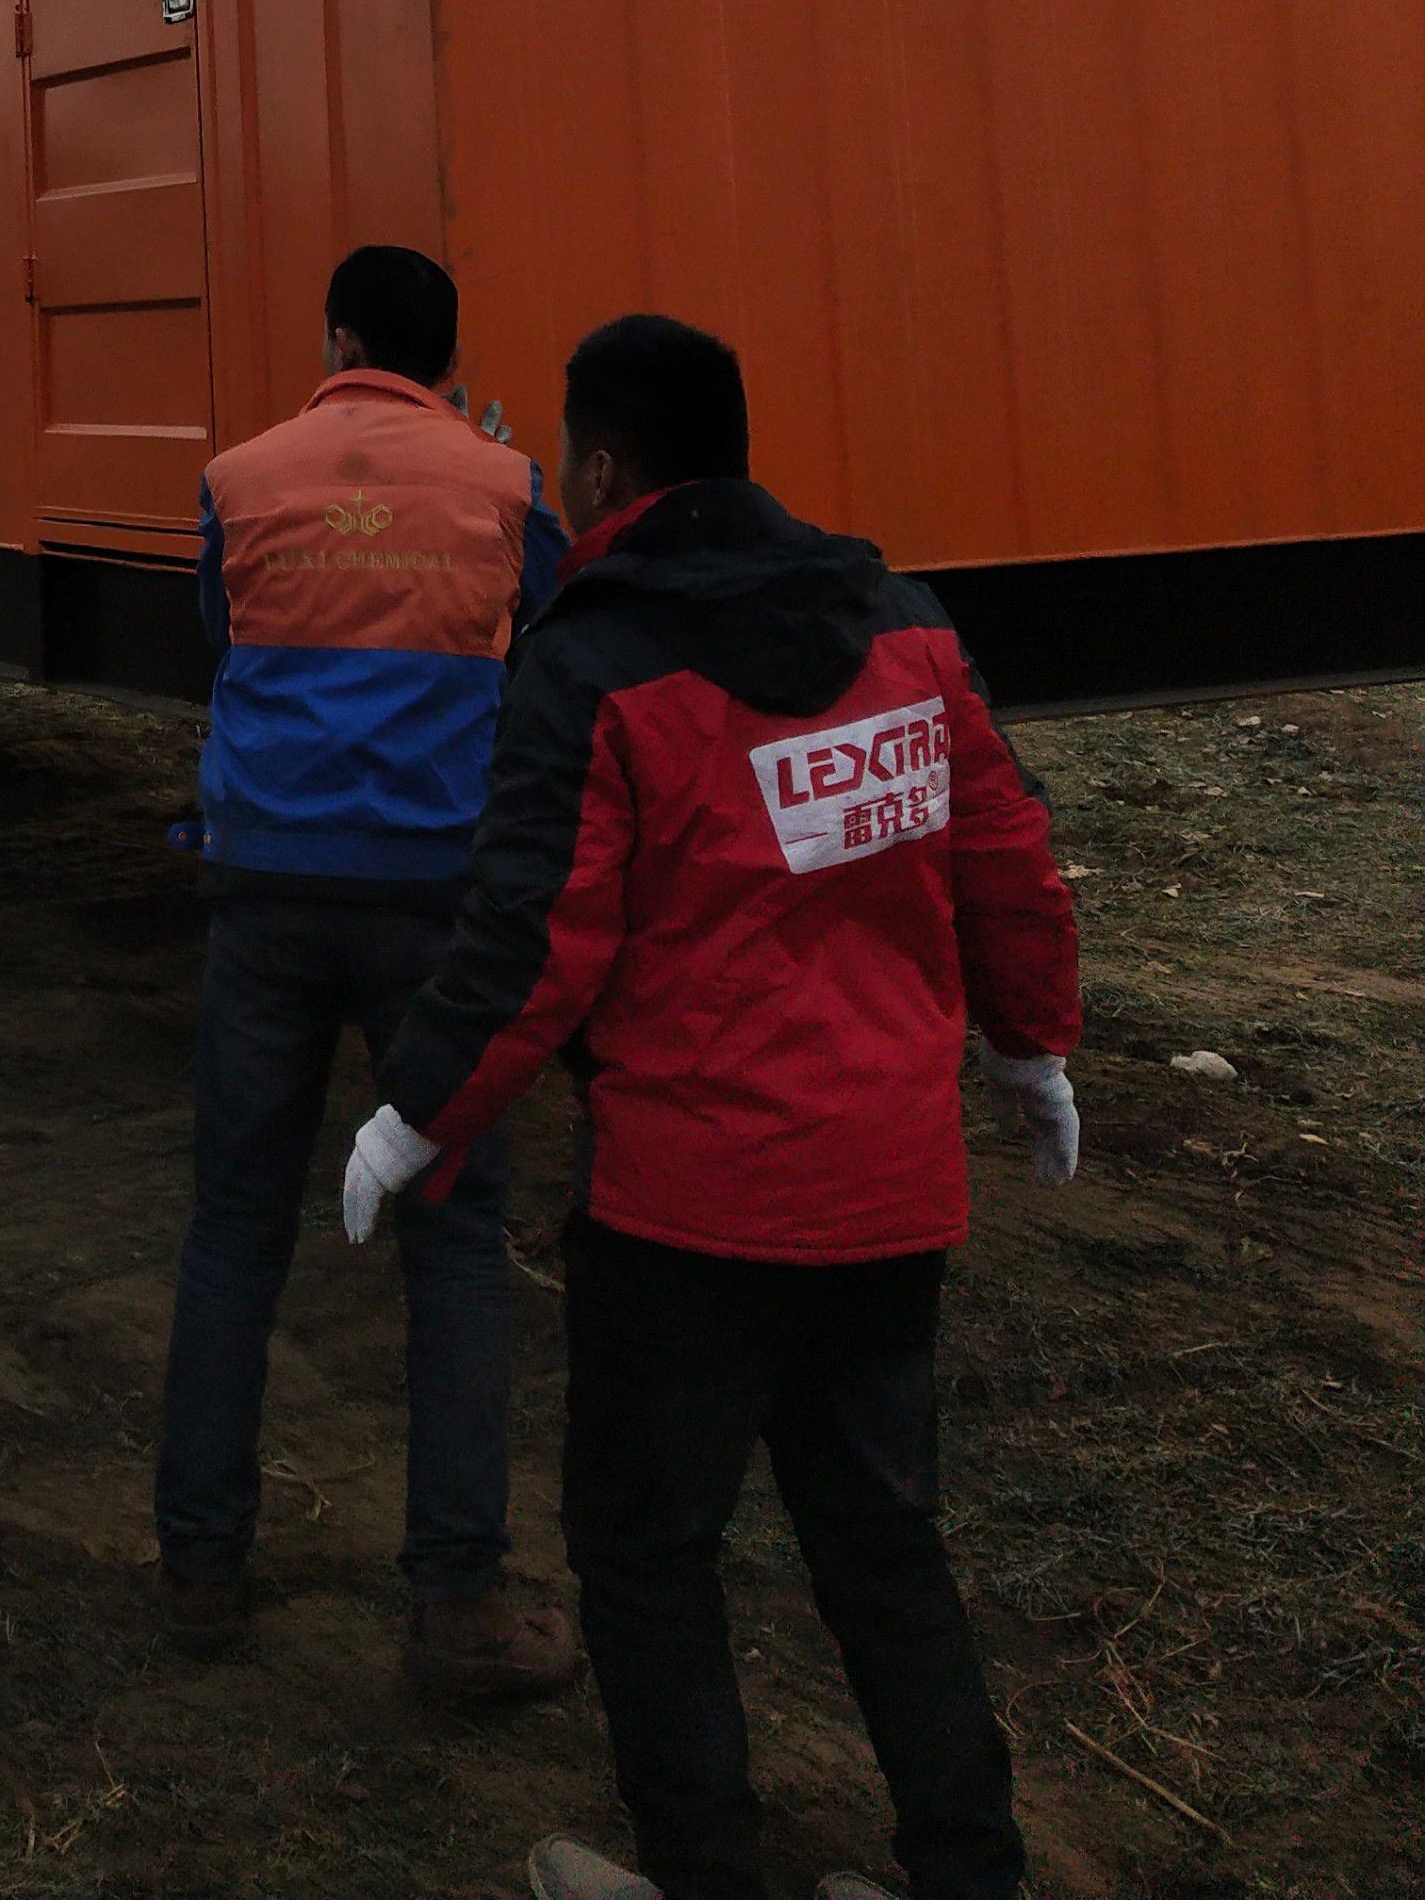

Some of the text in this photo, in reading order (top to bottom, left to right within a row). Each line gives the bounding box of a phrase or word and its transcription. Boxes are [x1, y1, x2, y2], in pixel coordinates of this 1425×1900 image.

[334, 548, 455, 571] CHEMICAL
[842, 786, 931, 849] 雷克多
